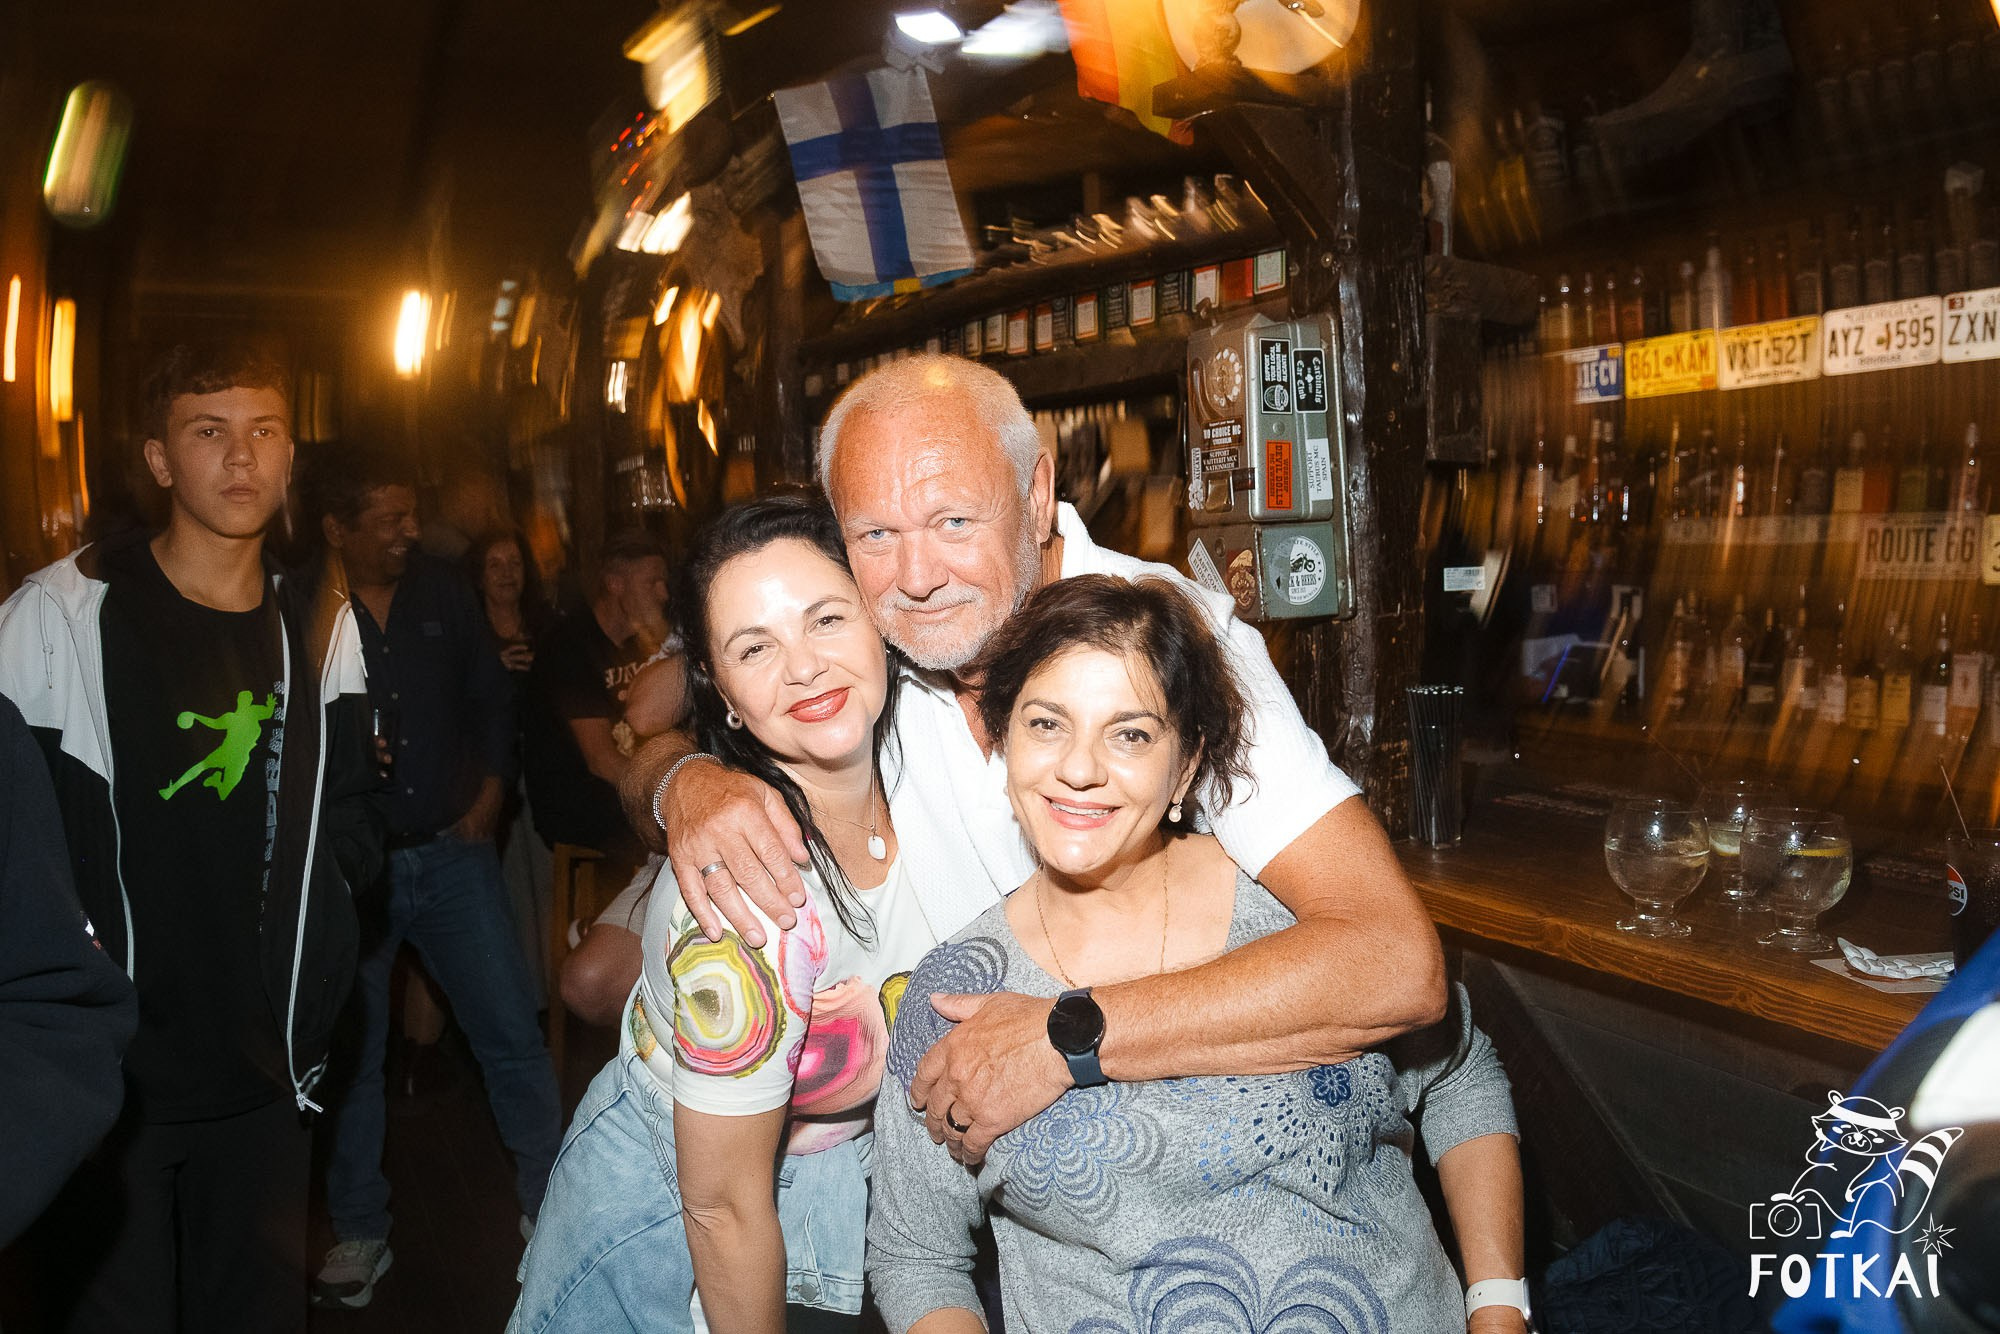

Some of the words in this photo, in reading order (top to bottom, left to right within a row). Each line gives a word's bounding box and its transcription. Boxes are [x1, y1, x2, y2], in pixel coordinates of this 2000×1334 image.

[1829, 326, 1864, 358] AYZ
[1885, 315, 1935, 351] 1595
[1949, 310, 1997, 346] ZXN
[1296, 360, 1305, 376] Car
[1312, 356, 1323, 404] Cardinals
[1296, 379, 1306, 400] Club
[1313, 445, 1319, 460] MC
[1314, 460, 1322, 494] TAURUS
[1866, 527, 1937, 562] ROUTE
[1945, 526, 1975, 562] 66
